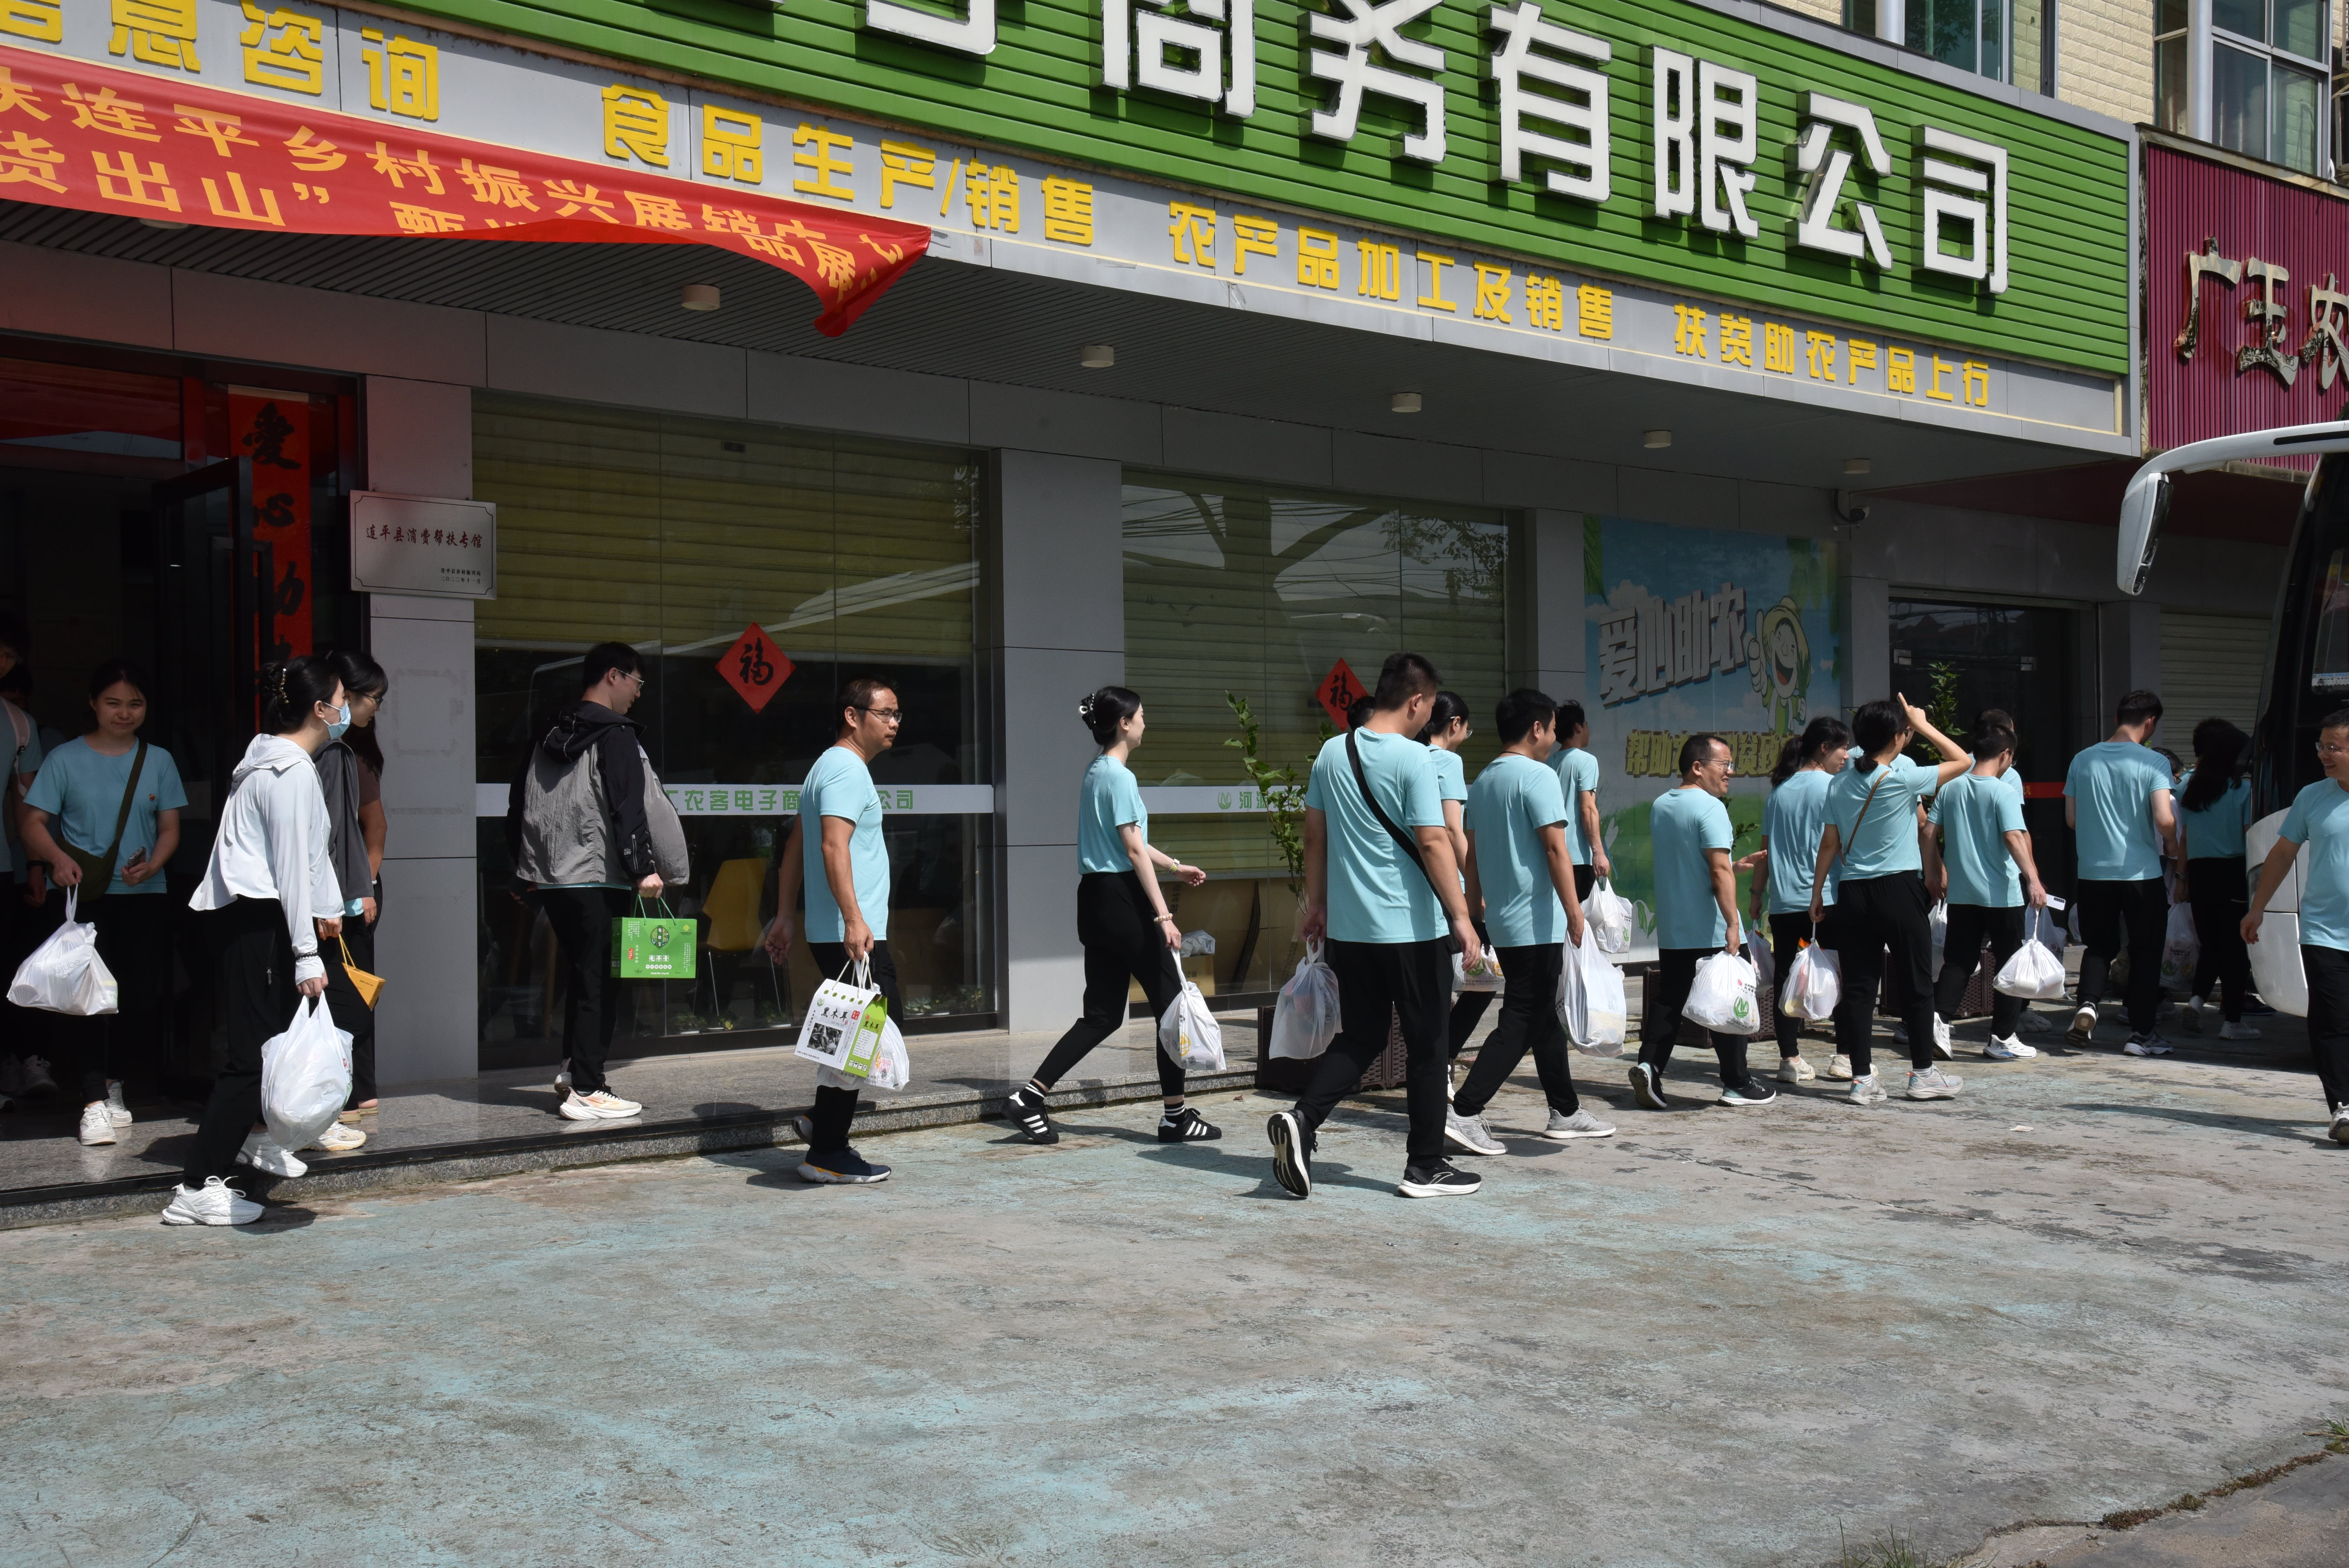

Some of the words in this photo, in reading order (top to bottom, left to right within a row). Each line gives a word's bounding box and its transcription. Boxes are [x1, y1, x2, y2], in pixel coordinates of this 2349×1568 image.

[601, 83, 1093, 245] 食品生产/销售
[1169, 201, 1613, 340] 农产品加工及销售
[1674, 304, 1989, 407] 扶贫助农产品上行
[740, 637, 774, 686] 福
[1600, 583, 1746, 707] 爱心助农
[821, 1007, 848, 1022] 黑木耳
